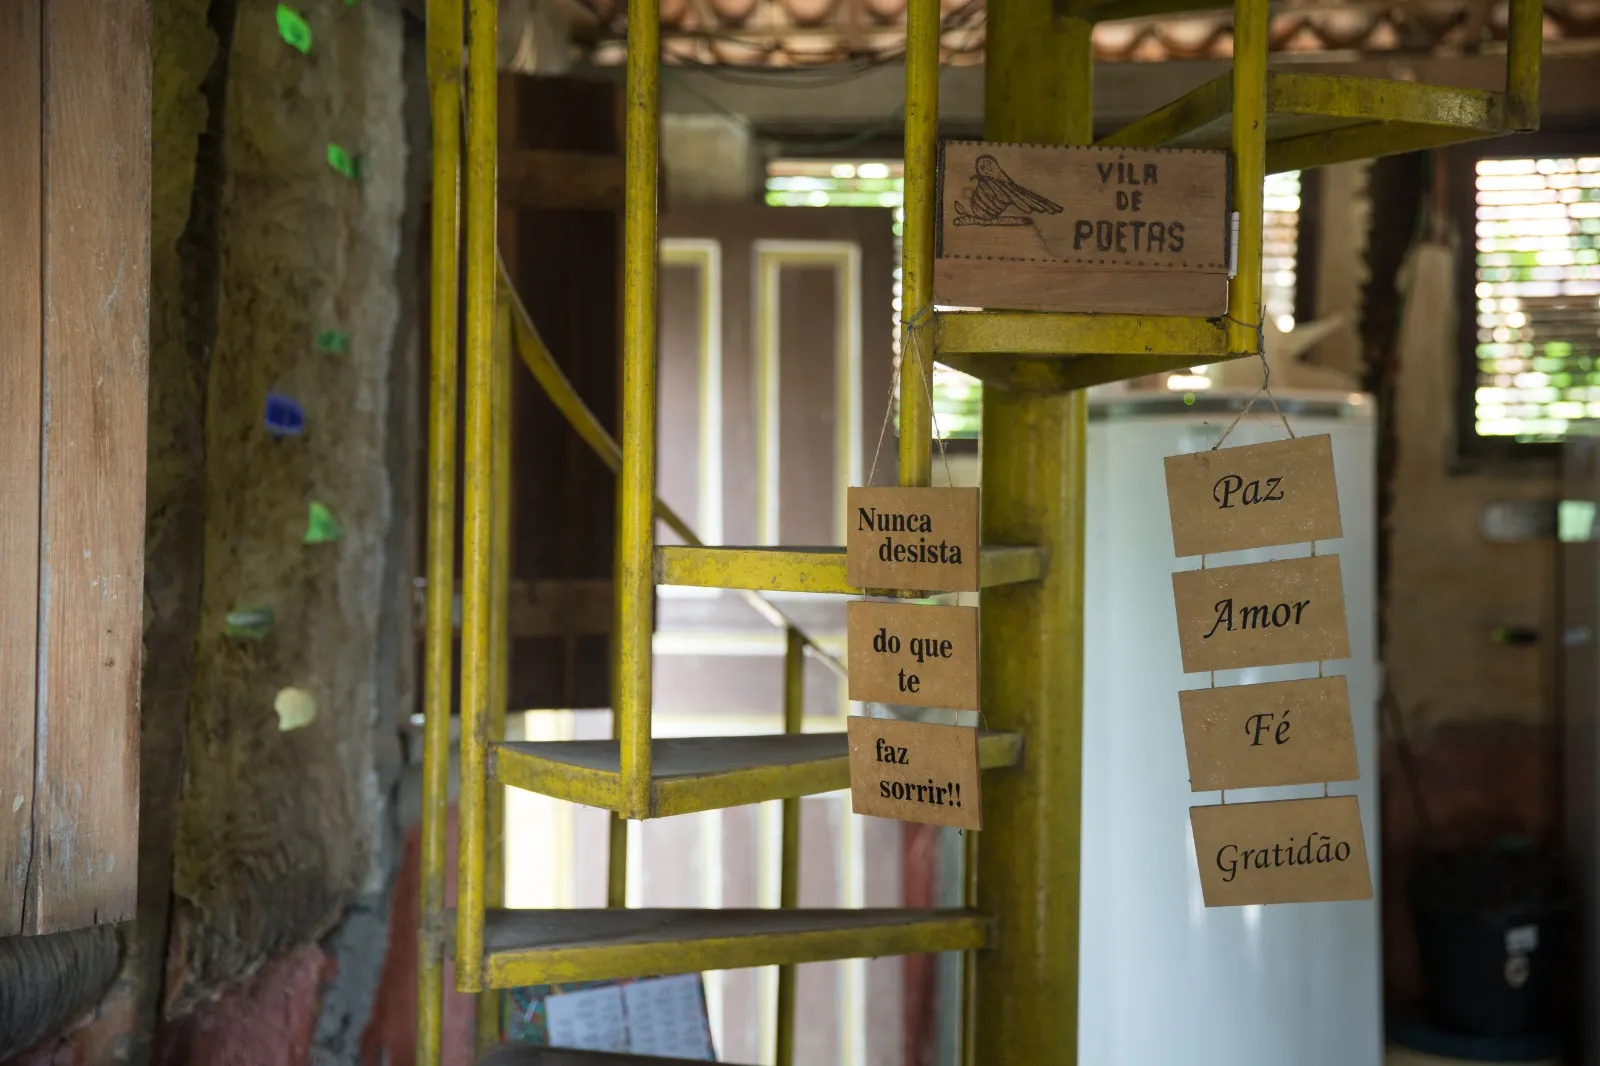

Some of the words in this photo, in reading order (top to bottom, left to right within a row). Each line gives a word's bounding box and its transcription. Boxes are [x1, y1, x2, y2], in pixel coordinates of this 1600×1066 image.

[1116, 190, 1142, 212] DE
[1073, 219, 1185, 253] POETAS
[1213, 475, 1283, 509] Paz
[858, 508, 932, 532] Nunca
[879, 537, 962, 564] desista
[1203, 599, 1310, 638] Amor
[873, 628, 900, 653] do
[910, 638, 952, 662] que
[898, 668, 920, 693] te
[1245, 710, 1290, 746] Fé
[876, 738, 908, 764] faz
[880, 779, 961, 807] sorrir!!
[1217, 832, 1350, 882] Gratidão
